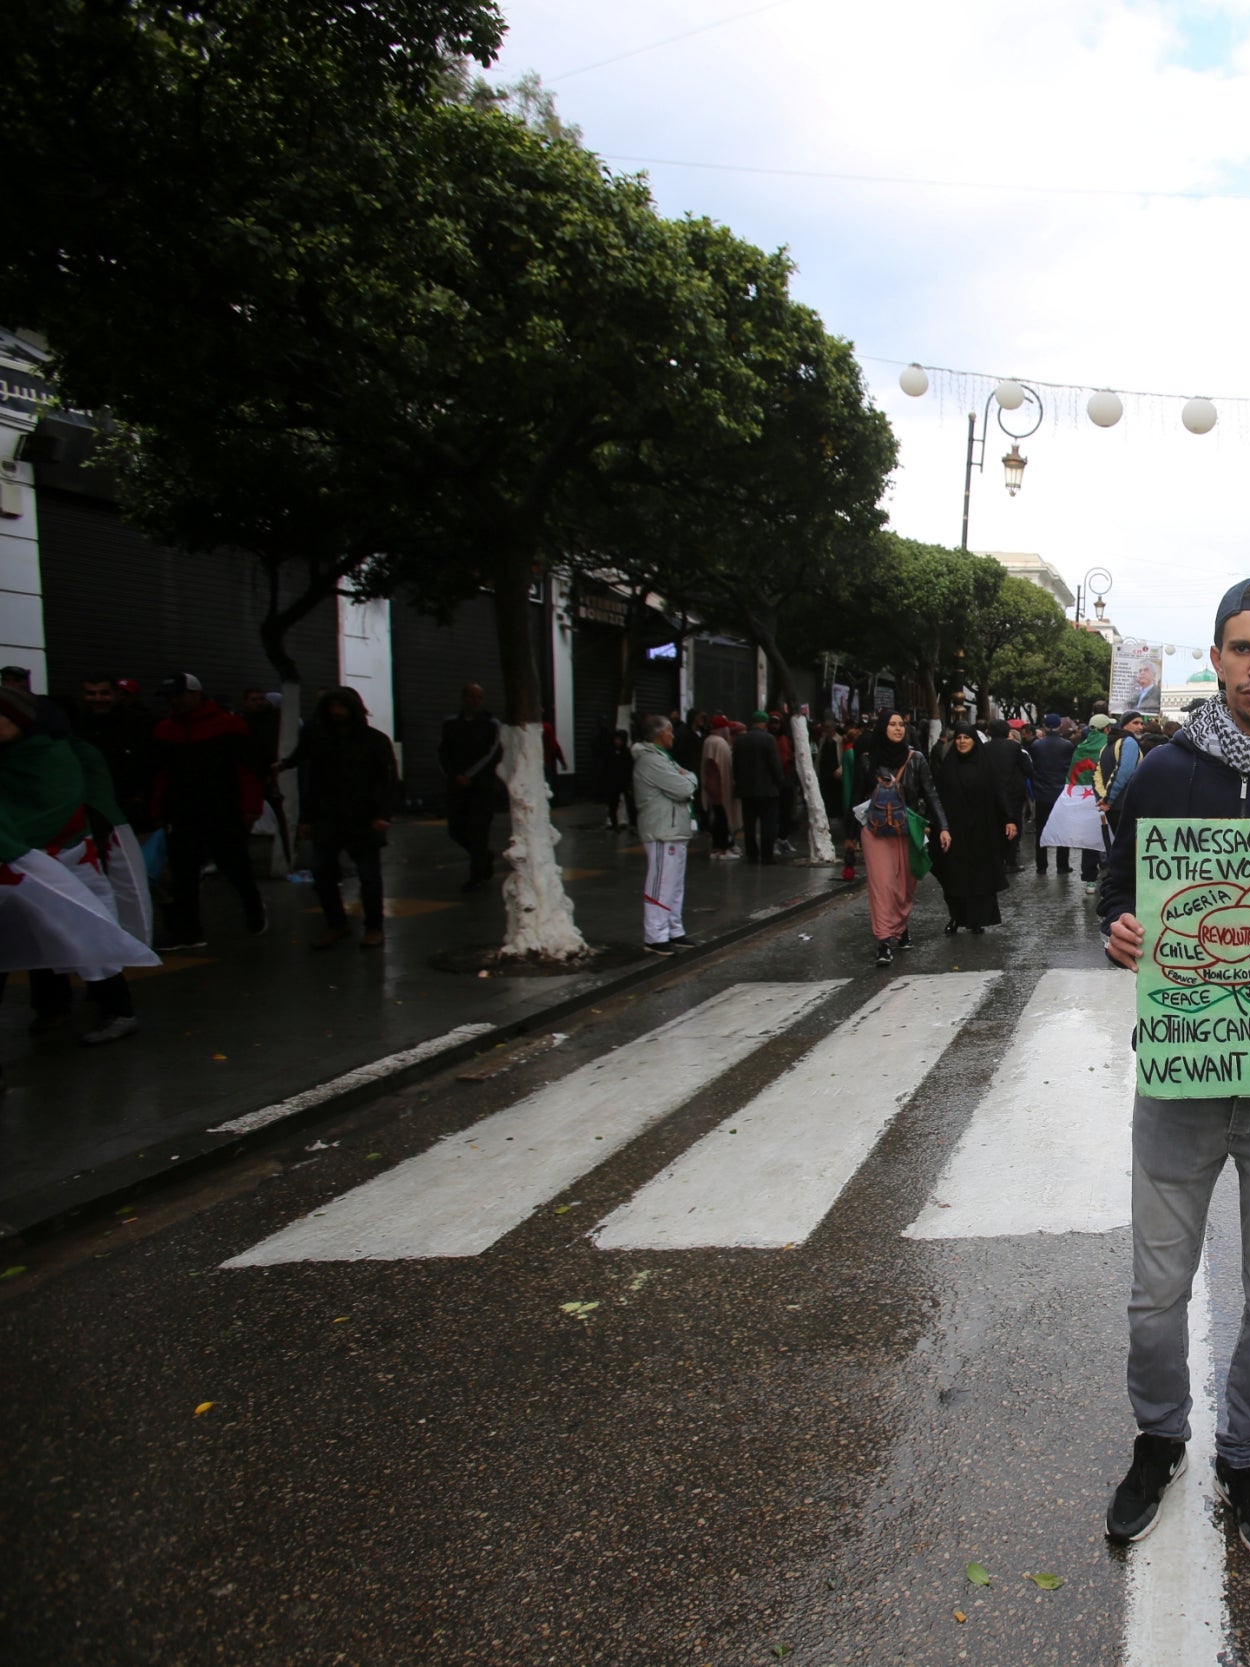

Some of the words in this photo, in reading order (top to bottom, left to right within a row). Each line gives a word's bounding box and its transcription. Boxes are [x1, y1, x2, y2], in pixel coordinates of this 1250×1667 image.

[1145, 825, 1167, 852] A
[1166, 890, 1231, 921] ALGERIA
[1159, 942, 1205, 960] CHILE
[1168, 970, 1197, 984] FRANCE
[1162, 990, 1211, 1006] PEACE
[1139, 1014, 1211, 1043] NOTHING
[1182, 1052, 1248, 1082] WANT
